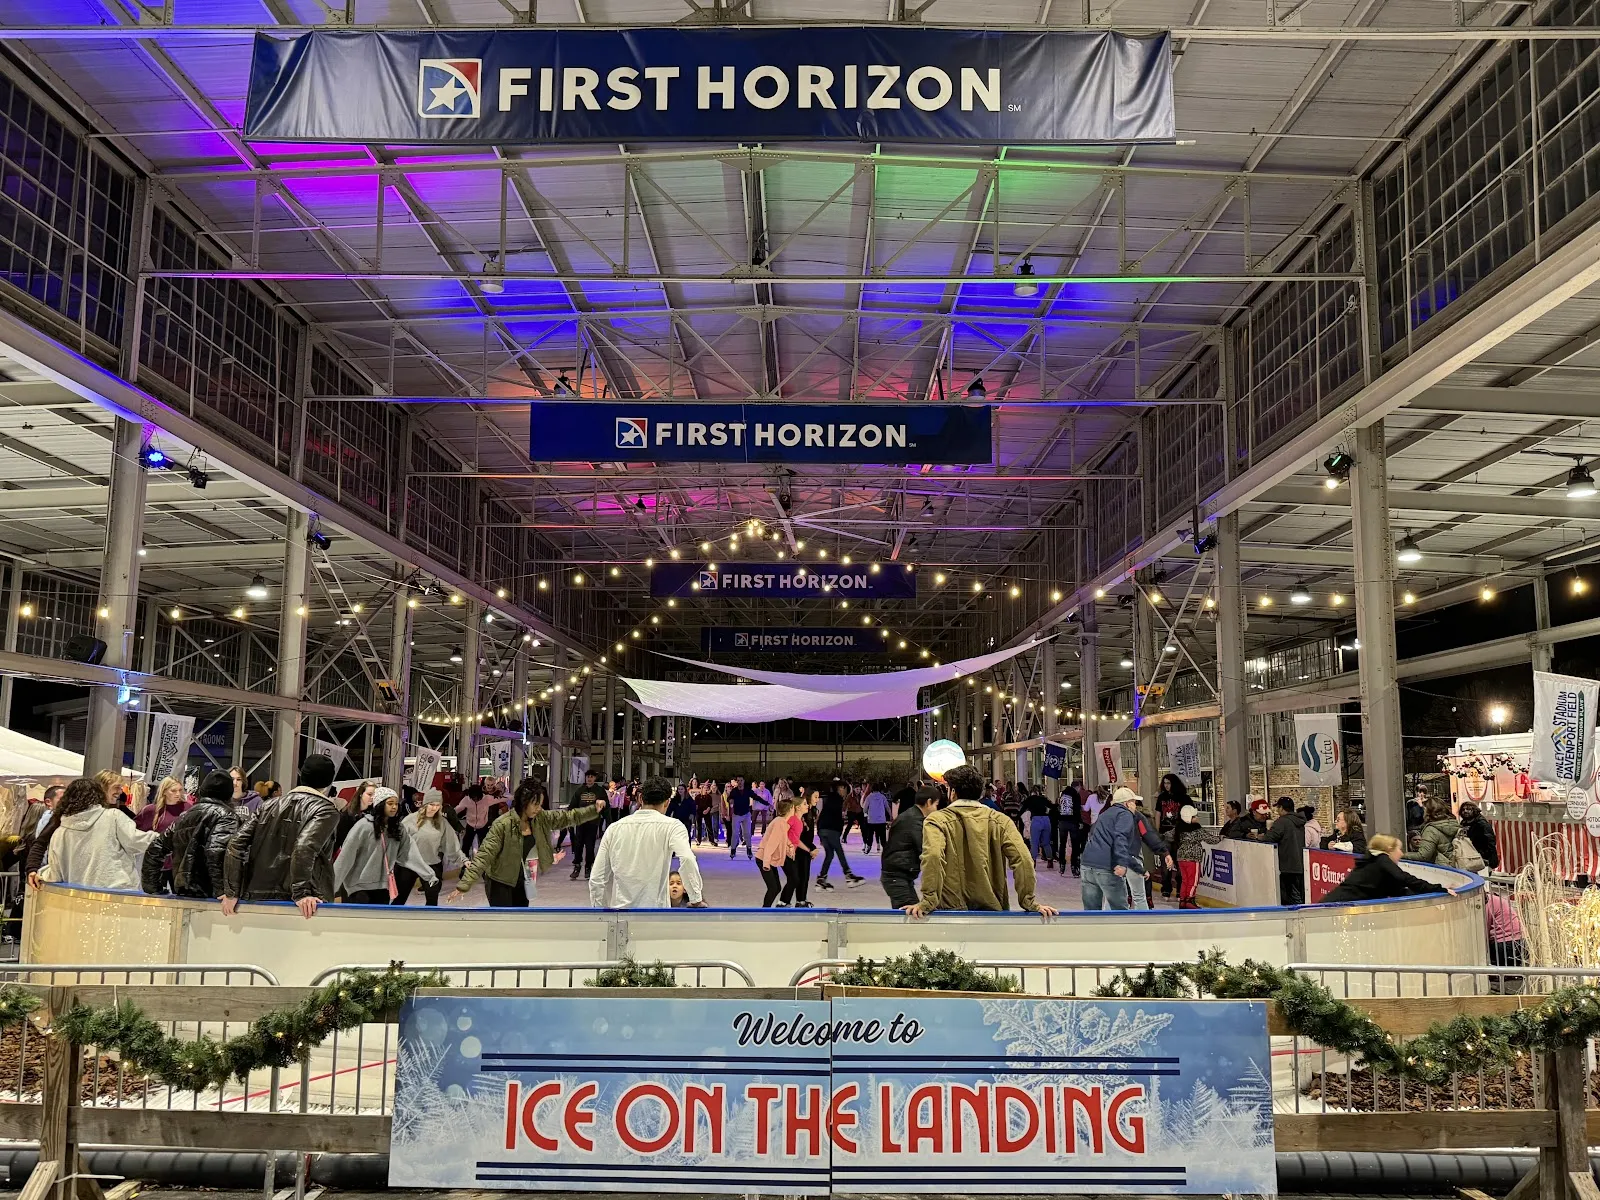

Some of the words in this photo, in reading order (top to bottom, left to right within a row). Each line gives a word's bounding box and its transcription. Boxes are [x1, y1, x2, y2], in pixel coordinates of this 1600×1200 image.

[498, 66, 680, 111] FIRST
[697, 65, 1000, 111] HORIZON
[1007, 104, 1021, 112] SM
[655, 422, 747, 446] FIRST
[755, 423, 906, 448] HORIZON
[722, 574, 775, 589] FIRST
[779, 574, 867, 589] HORIZON
[751, 635, 788, 646] FIRST
[792, 635, 854, 646] HORIZON
[1552, 691, 1568, 727] STADIUM
[1567, 692, 1577, 718] FIELD
[1563, 720, 1577, 780] DAVENPORT
[164, 758, 174, 777] STADI
[1556, 751, 1565, 779] FINLEY
[734, 1011, 884, 1047] Welcome
[889, 1013, 924, 1044] to
[505, 1082, 597, 1151] ICE
[615, 1083, 724, 1154] ON
[747, 1086, 858, 1156] THE
[881, 1086, 1146, 1154] LANDING
